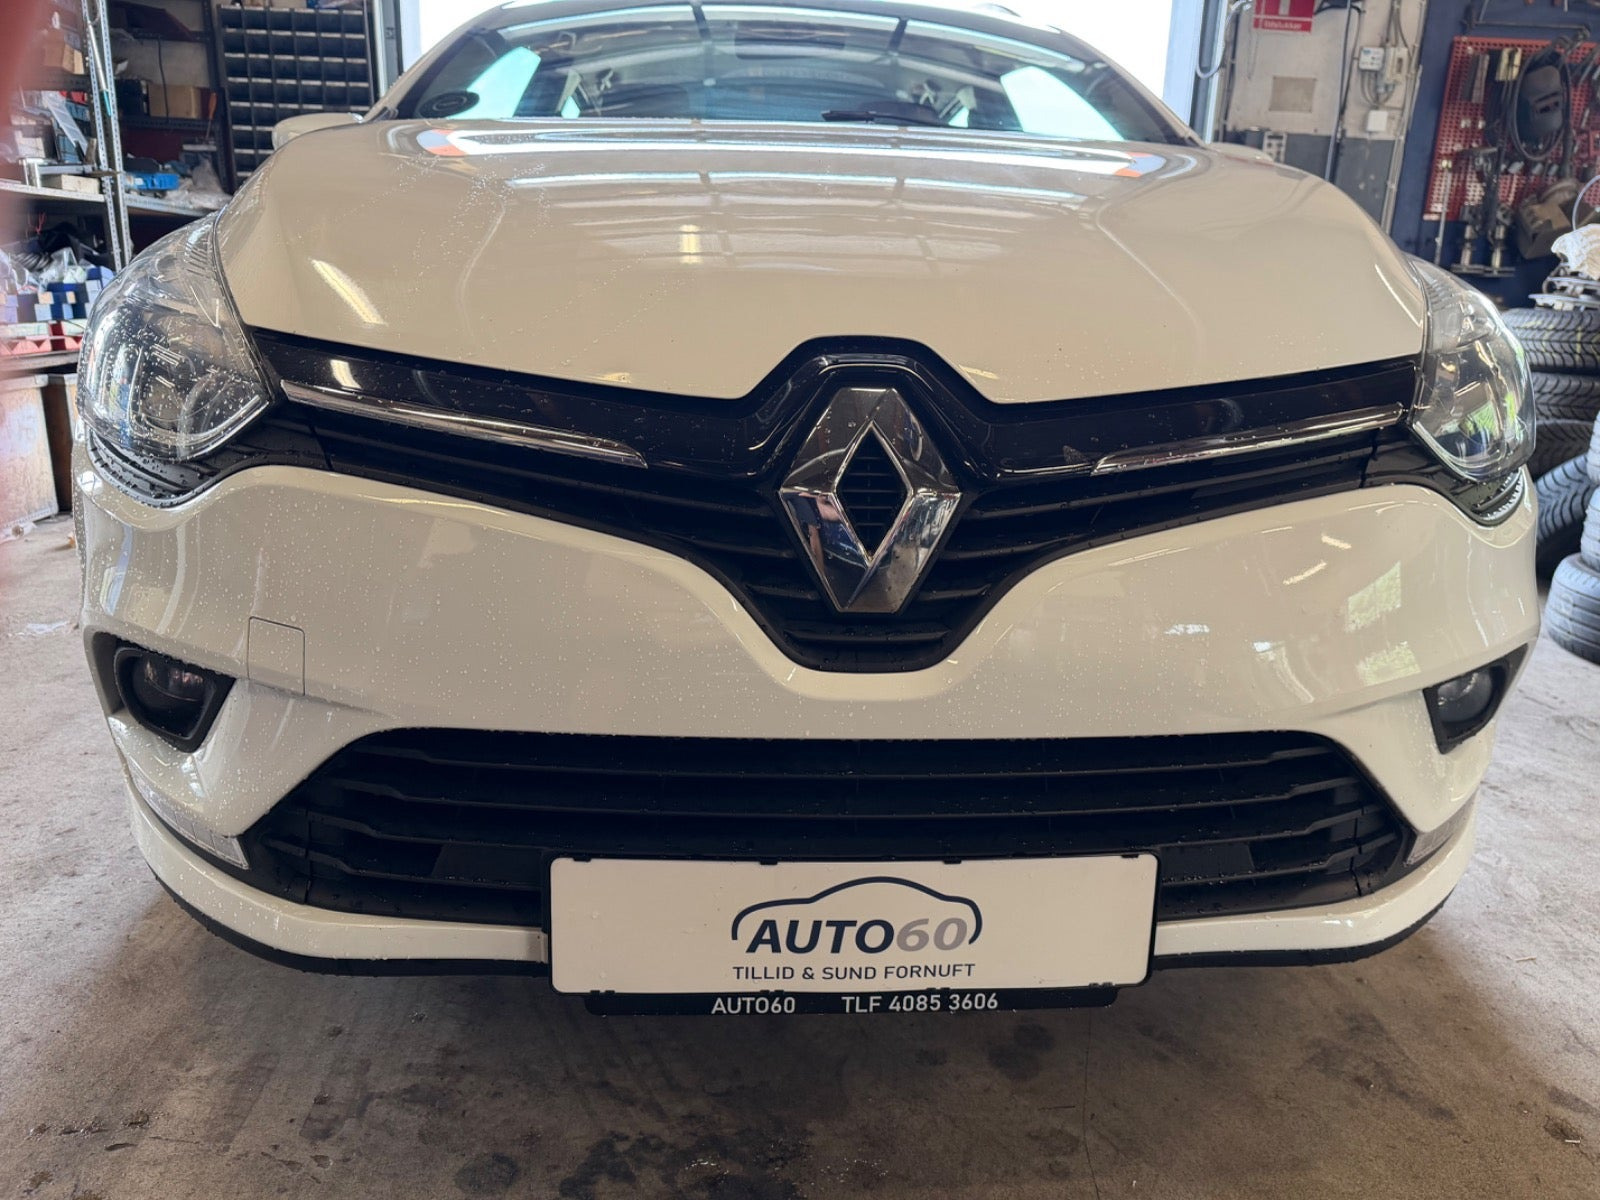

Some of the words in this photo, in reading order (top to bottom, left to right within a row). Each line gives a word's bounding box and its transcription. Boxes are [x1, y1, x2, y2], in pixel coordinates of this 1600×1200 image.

[746, 917, 967, 954] AUTO60
[732, 966, 795, 980] TILLID
[801, 966, 815, 980] &
[821, 966, 877, 980] SUND
[884, 963, 976, 979] FORNUFT
[711, 996, 796, 1015] AUTO60
[841, 996, 882, 1013] TLF
[888, 994, 941, 1012] 4085
[948, 992, 998, 1010] 3606
